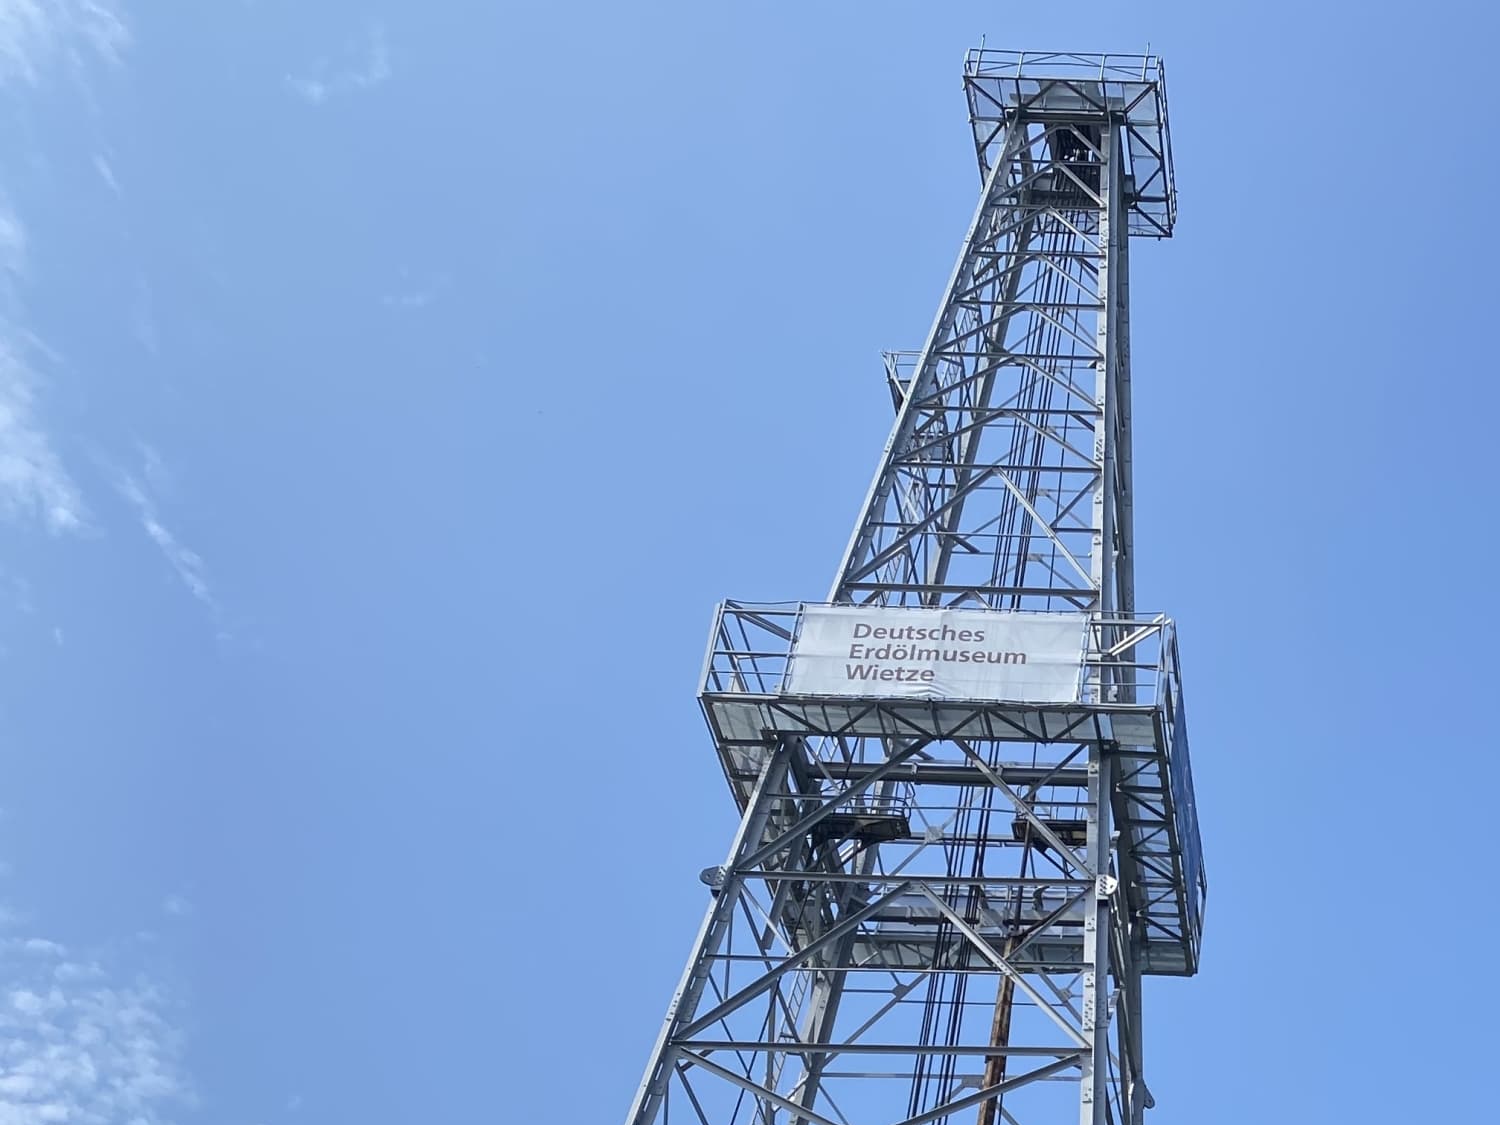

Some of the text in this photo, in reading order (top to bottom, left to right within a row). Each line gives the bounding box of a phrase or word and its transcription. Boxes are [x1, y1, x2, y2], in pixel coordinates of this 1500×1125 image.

[853, 623, 985, 642] Deutsches
[849, 643, 1027, 665] Erdölmuseum
[846, 664, 935, 682] Wietze
